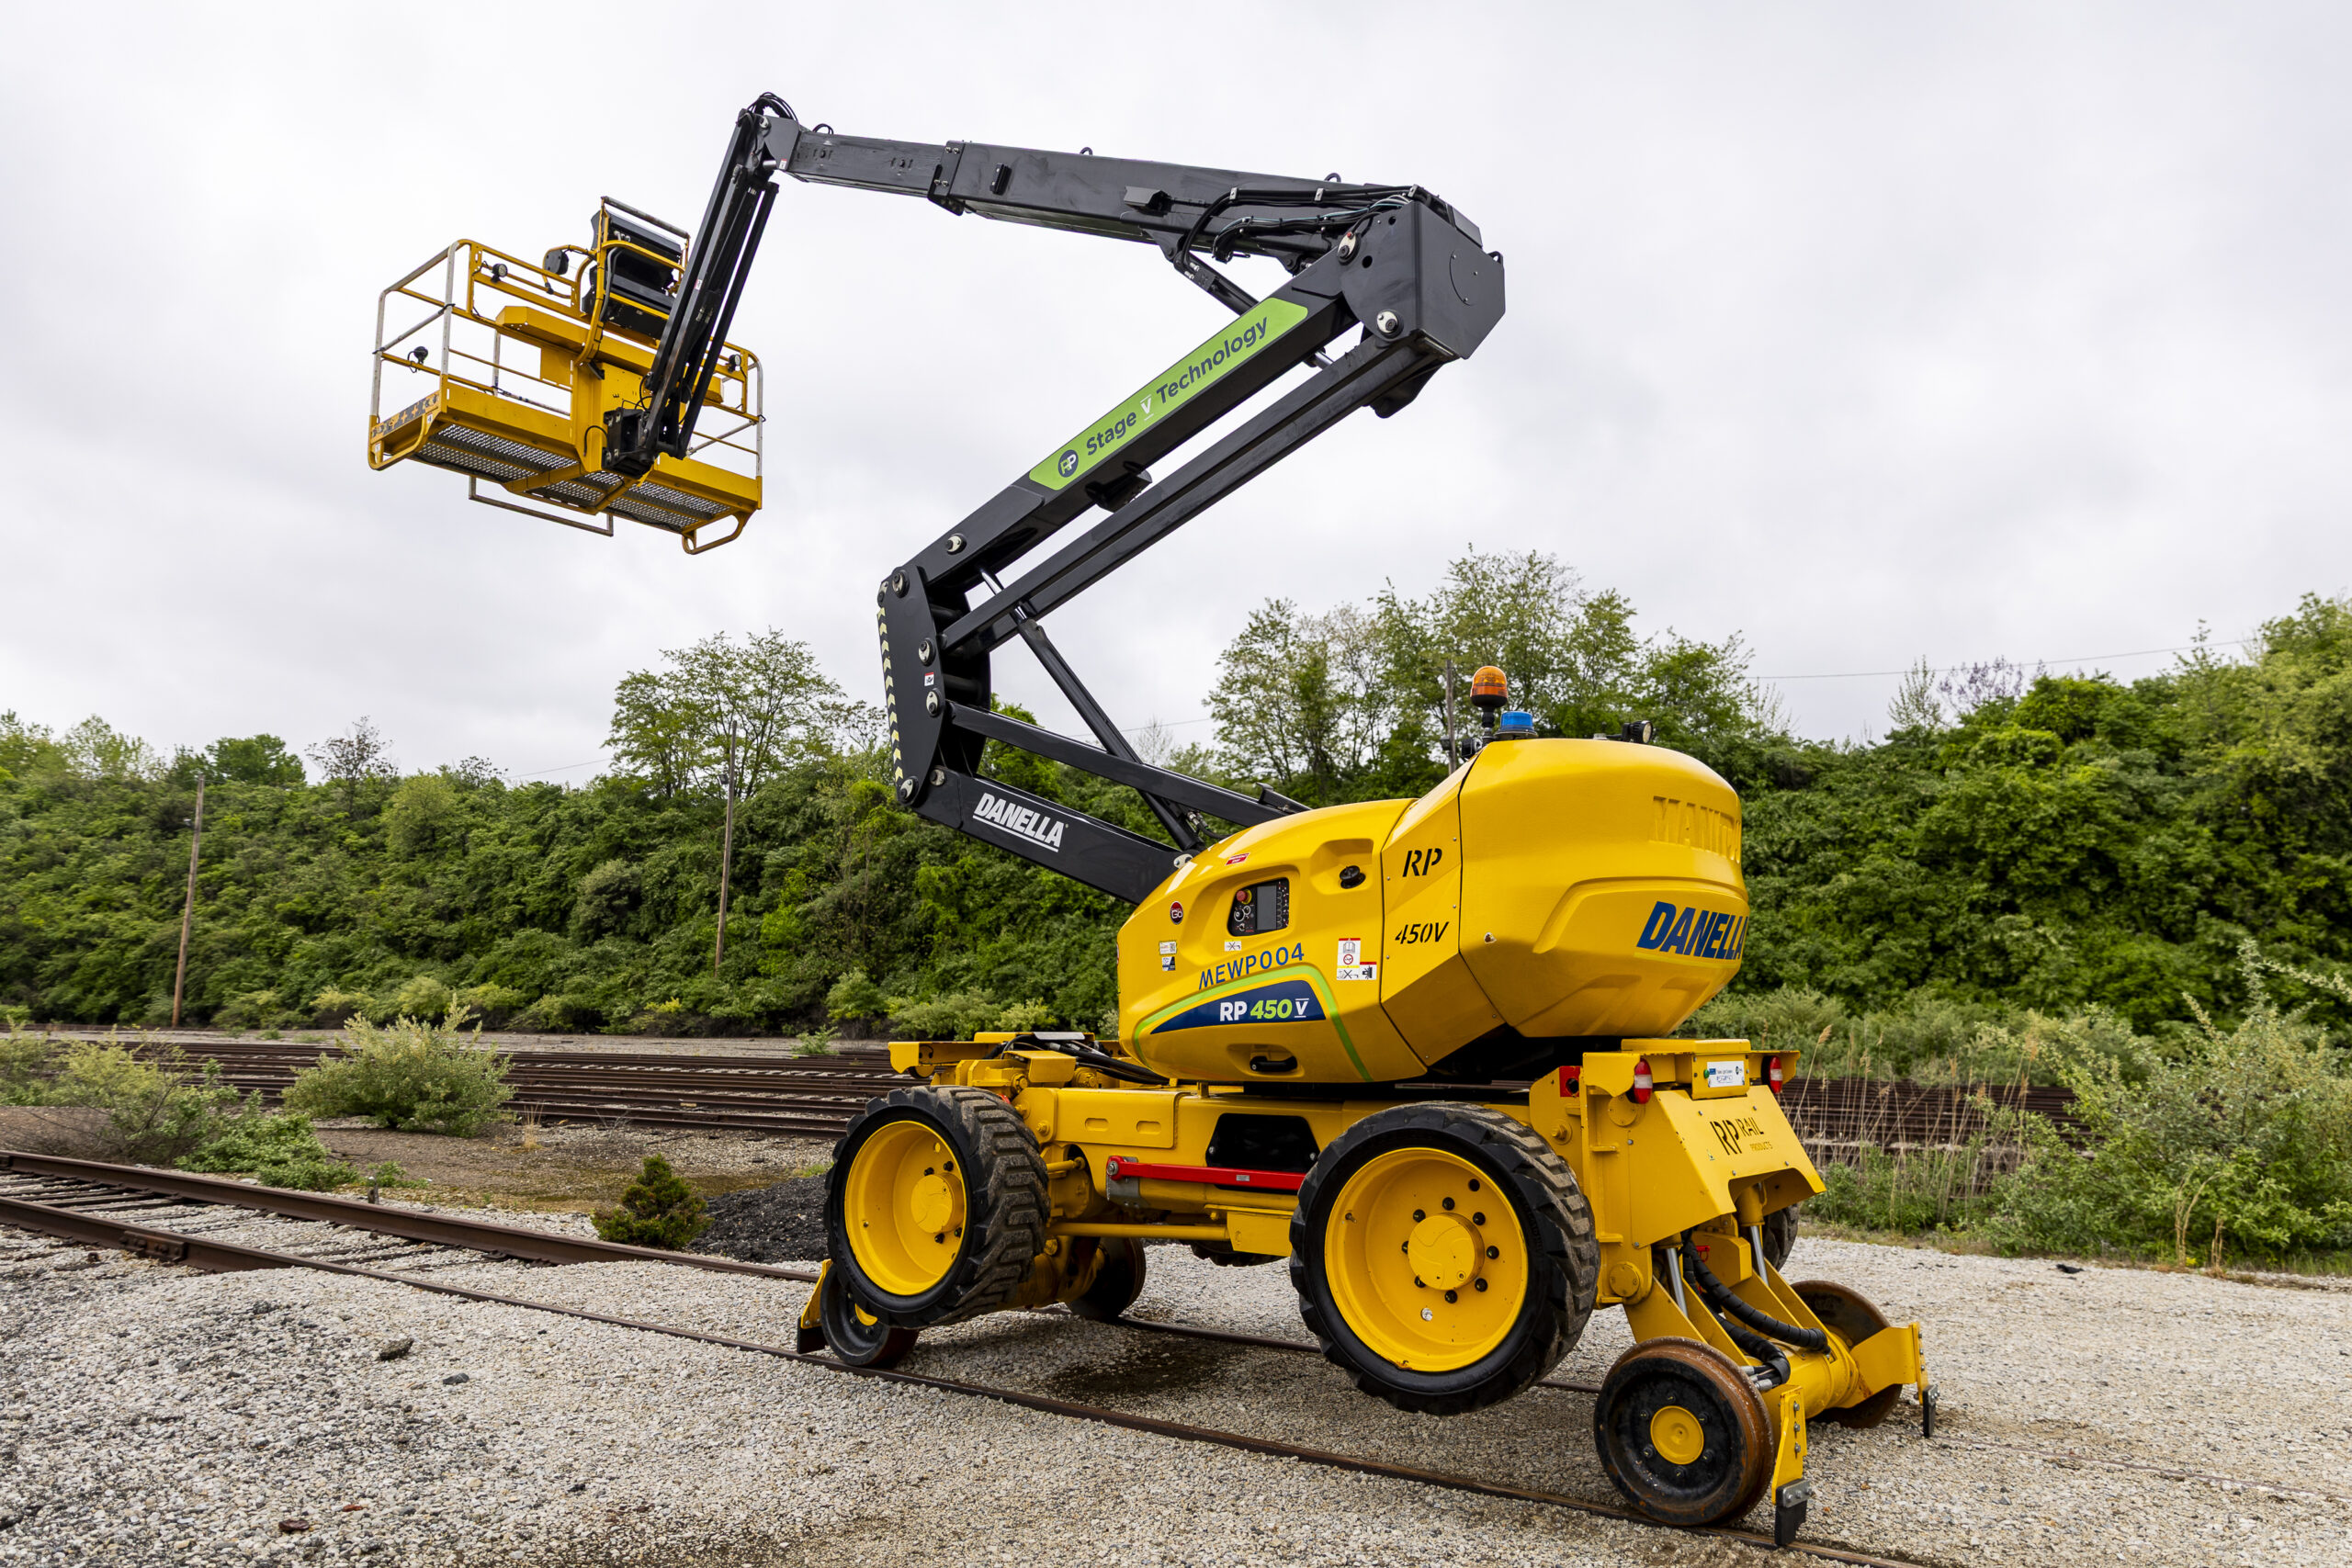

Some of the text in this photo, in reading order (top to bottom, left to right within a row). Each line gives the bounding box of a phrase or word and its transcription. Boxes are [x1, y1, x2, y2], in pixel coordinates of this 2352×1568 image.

[1086, 316, 1267, 456] Stage V Technology
[1060, 454, 1077, 474] RP
[974, 793, 1064, 848] DANELLA
[1402, 848, 1442, 877] RP
[1395, 921, 1449, 944] 450V
[1636, 900, 1749, 961] DANELLA
[1198, 942, 1305, 990] MEWP004
[1219, 998, 1310, 1022] RP 450 V
[1710, 1117, 1764, 1156] RP RAIL
